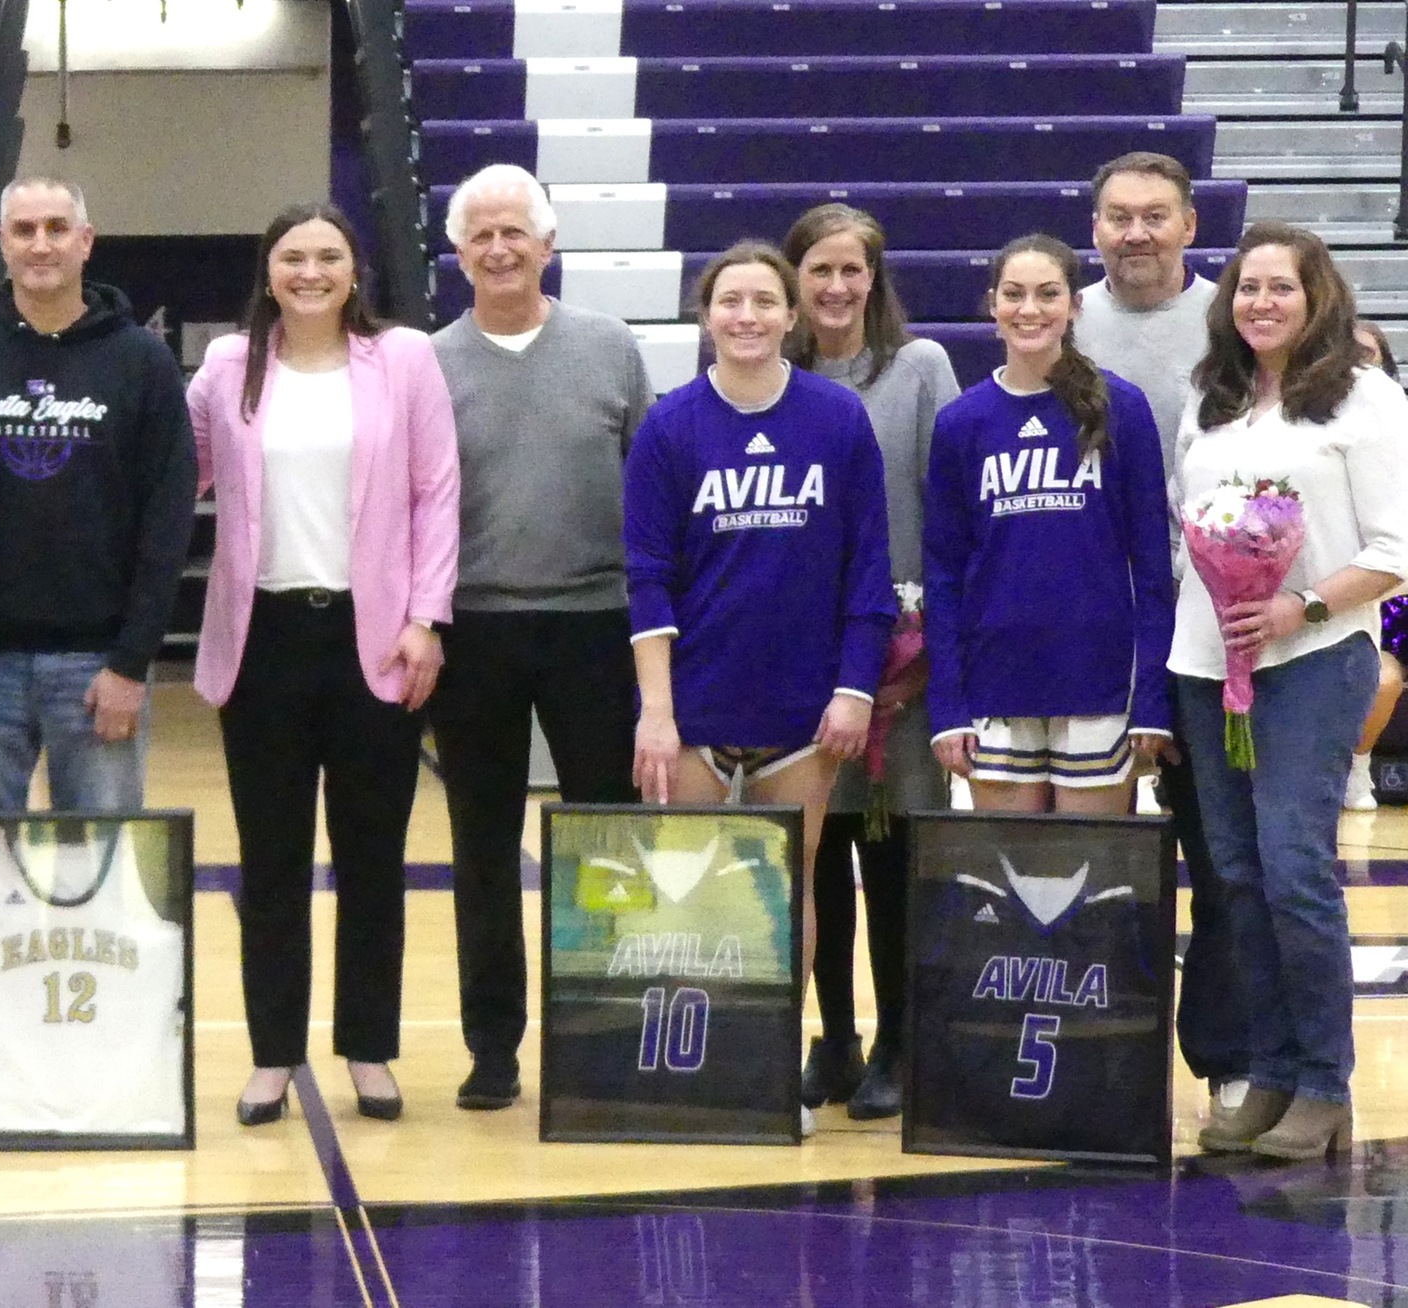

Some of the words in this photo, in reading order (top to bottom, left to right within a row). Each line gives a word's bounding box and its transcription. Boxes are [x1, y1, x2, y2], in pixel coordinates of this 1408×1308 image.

[32, 394, 108, 425] Eagles
[693, 463, 825, 513] AVILA
[980, 447, 1102, 501] AVILA
[717, 511, 805, 528] BASKETBALL
[993, 494, 1082, 513] BASKETBALL
[0, 926, 140, 973] EAGLES
[607, 933, 743, 978] AVILA
[43, 970, 97, 1024] 12
[972, 955, 1108, 1008] AVILA
[638, 986, 710, 1072] 10
[1010, 1012, 1061, 1100] 5
